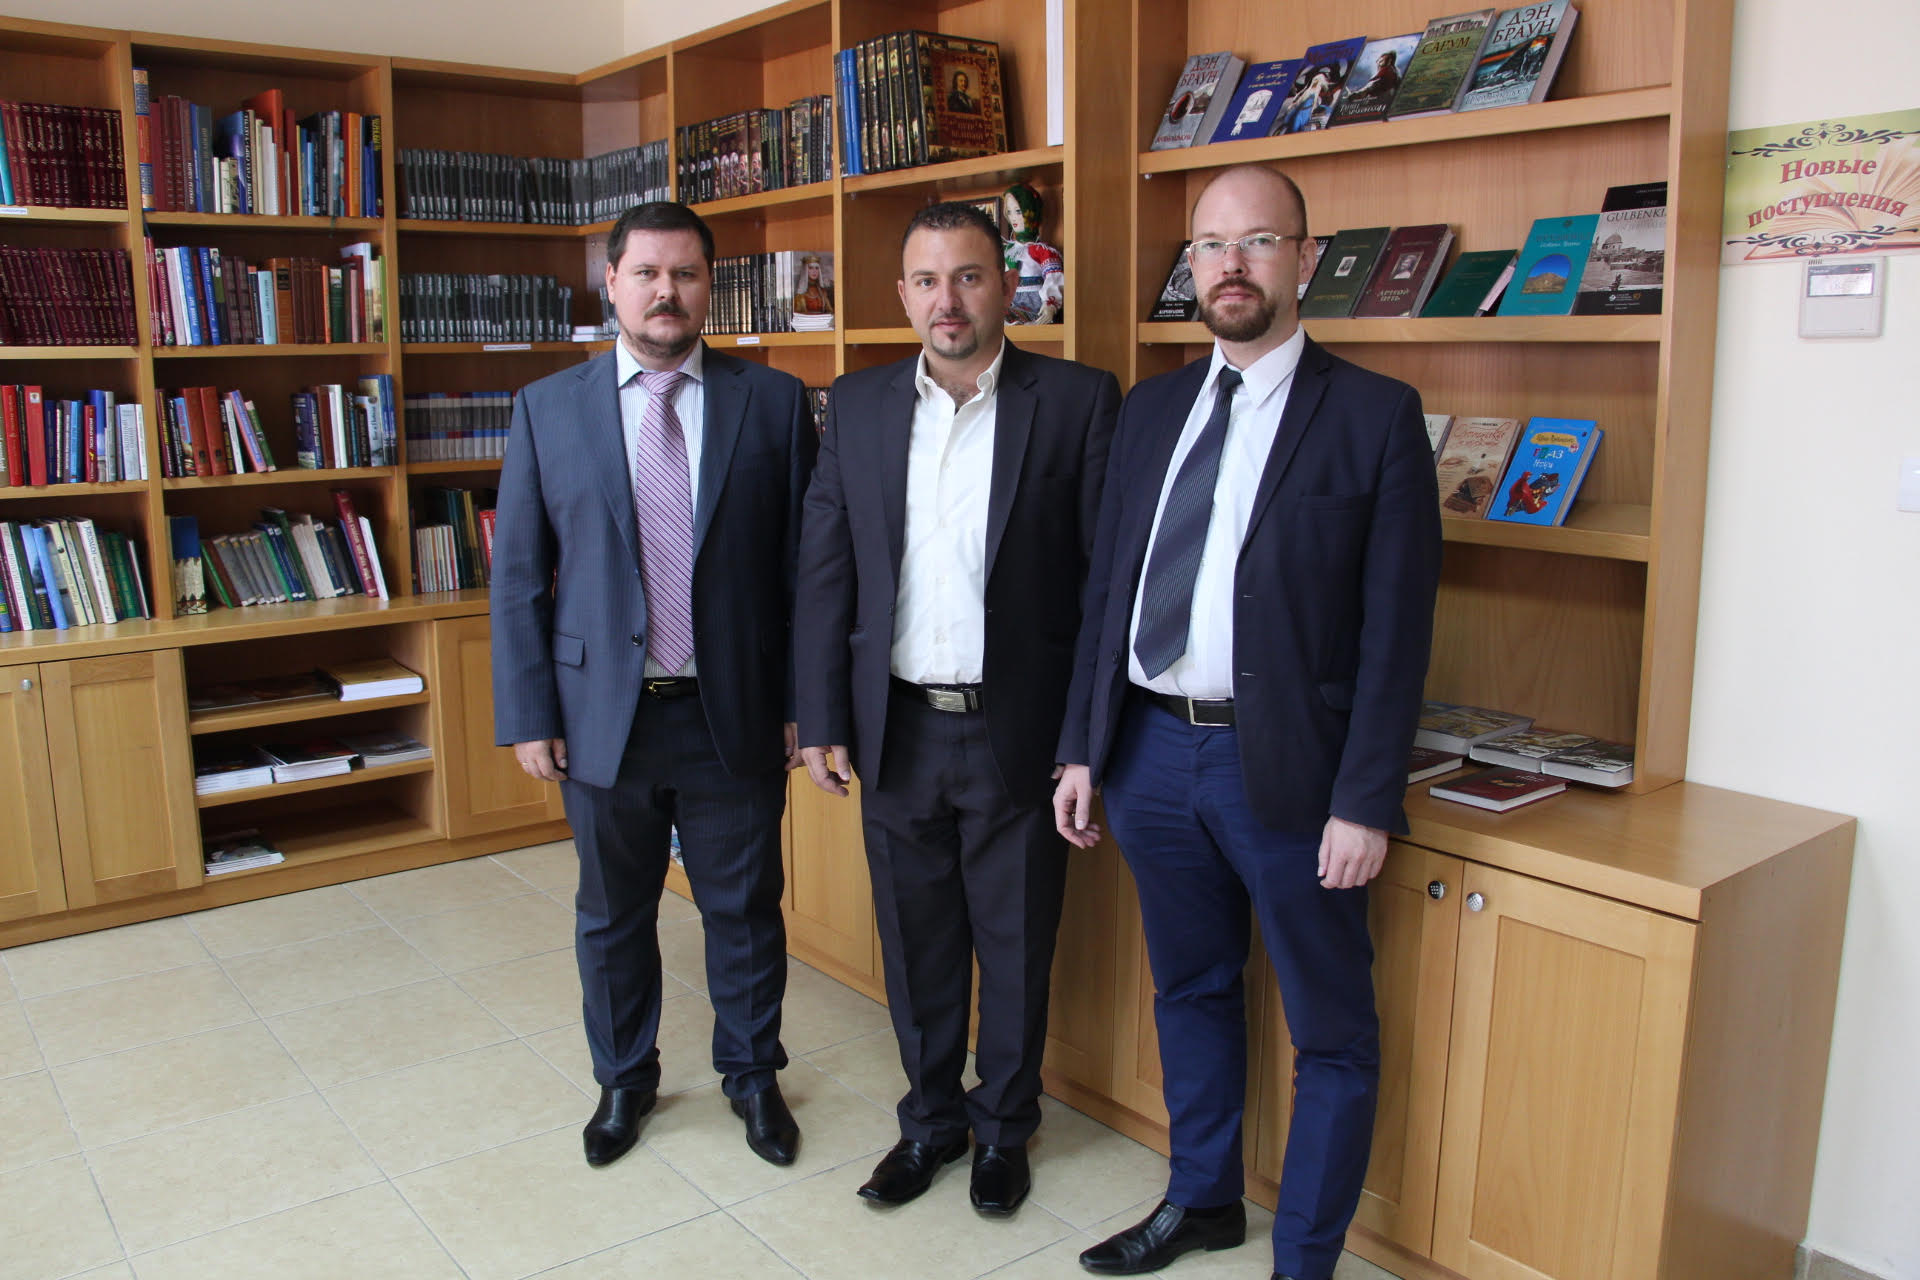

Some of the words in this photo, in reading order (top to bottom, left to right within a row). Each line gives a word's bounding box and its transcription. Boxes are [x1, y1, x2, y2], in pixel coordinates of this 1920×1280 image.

[1506, 4, 1553, 27] ДЭН
[1493, 18, 1554, 44] БРАУН
[1422, 36, 1471, 55] САРУМ
[1191, 56, 1220, 72] ДЭН
[1180, 70, 1218, 87] БРАУН
[1780, 157, 1877, 184] Новые
[1606, 208, 1667, 222] GULBENKI
[1747, 191, 1909, 229] поступления
